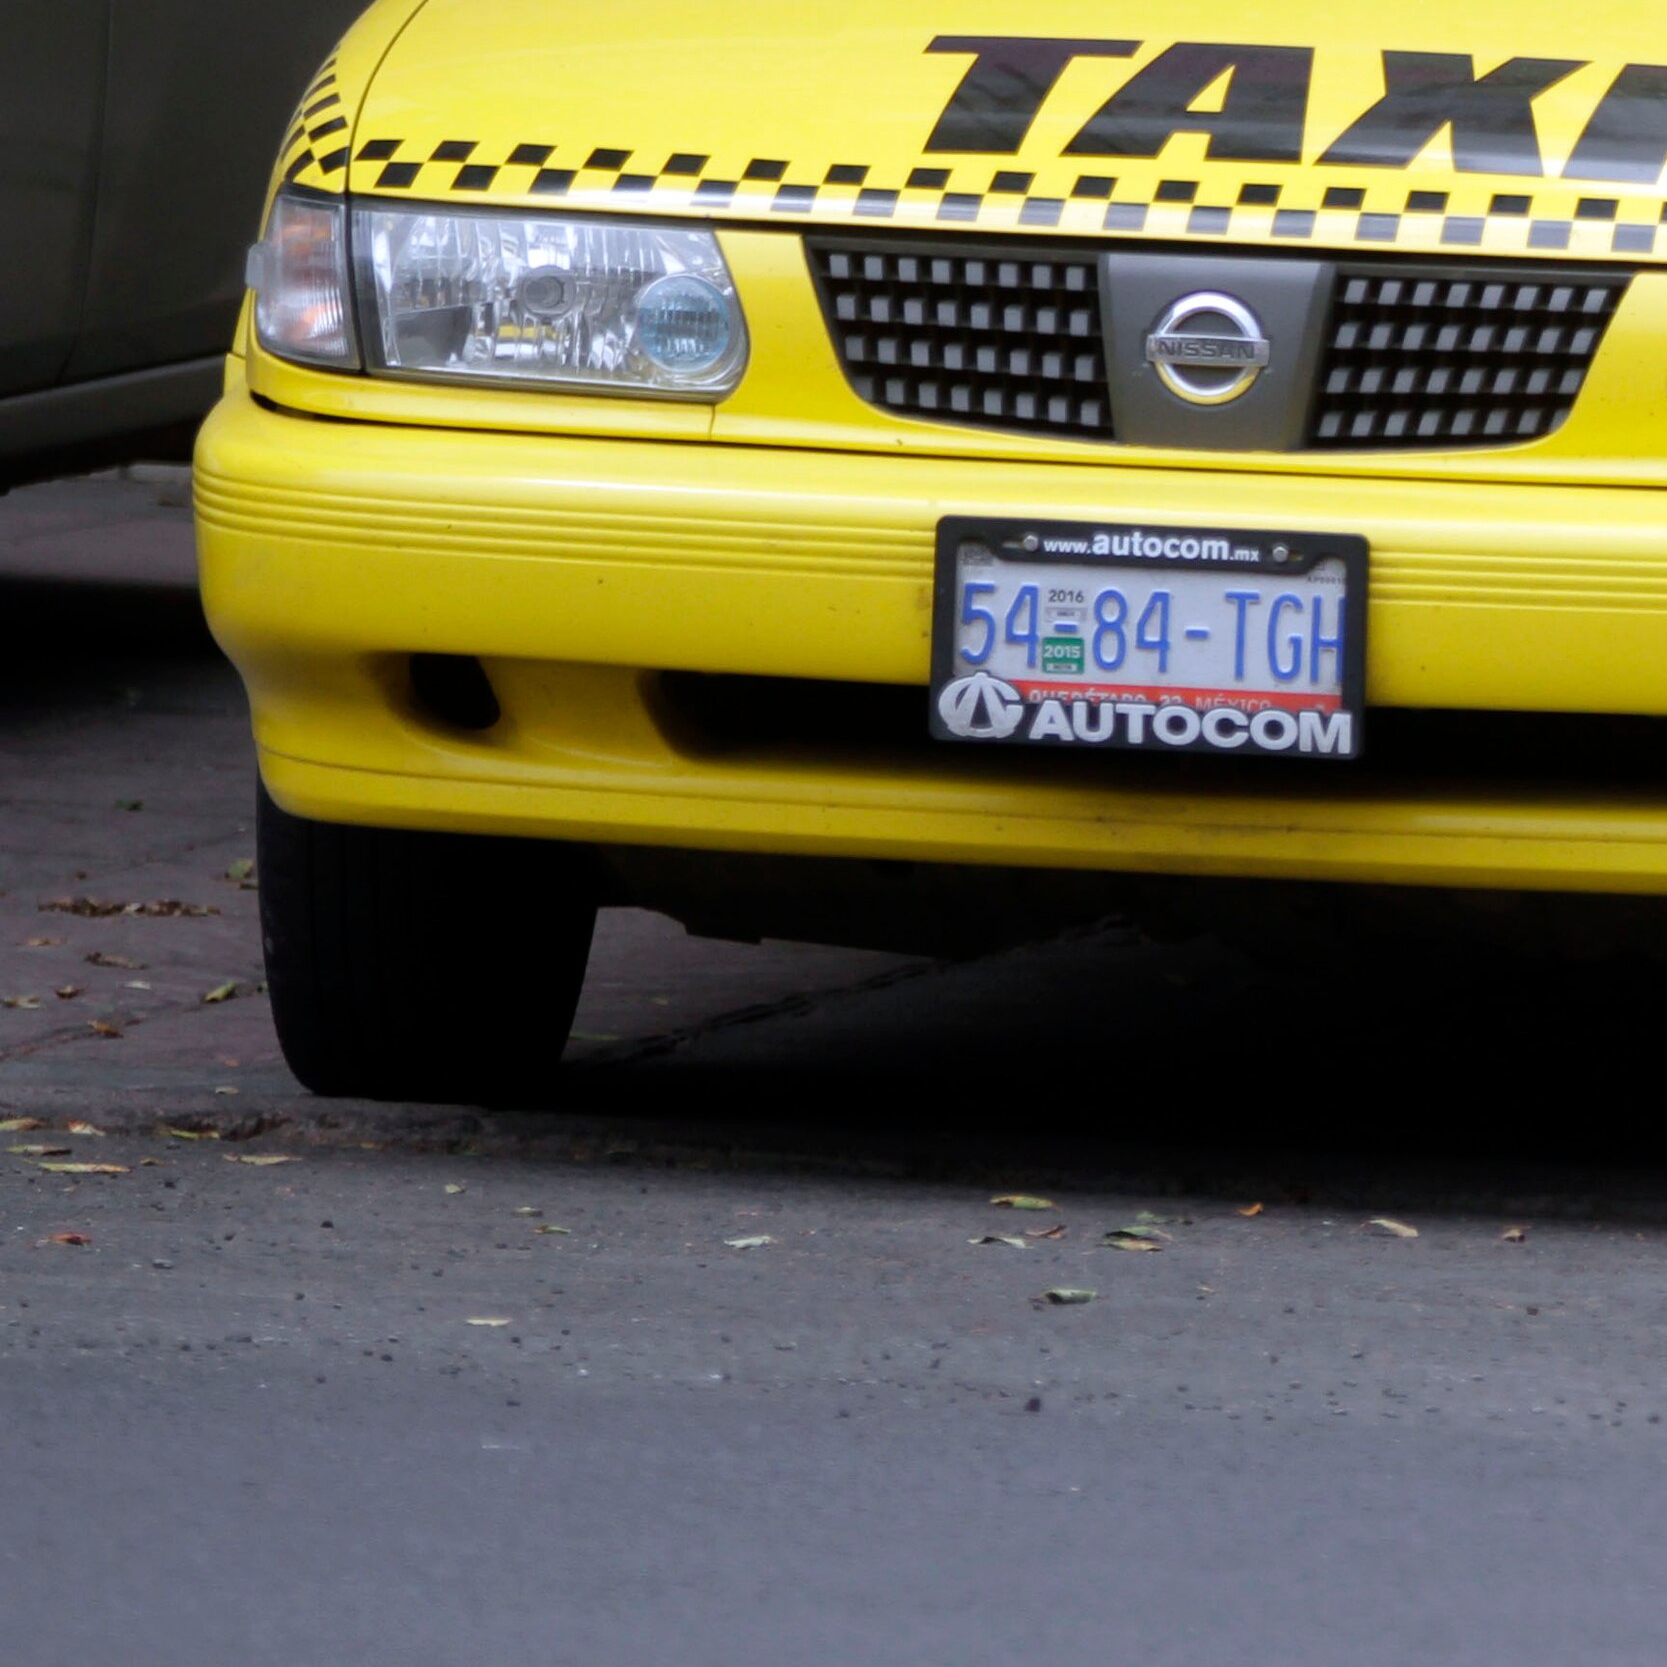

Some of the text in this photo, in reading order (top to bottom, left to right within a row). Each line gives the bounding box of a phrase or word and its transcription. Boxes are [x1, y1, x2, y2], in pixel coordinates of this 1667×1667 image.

[1158, 340, 1256, 360] NISSAN
[1043, 531, 1261, 563] www.autocom.mx
[1048, 589, 1085, 603] 2016
[959, 581, 1346, 684] 54-84-TGH
[1043, 645, 1082, 659] 2015
[1028, 700, 1353, 755] AUTOCOM
